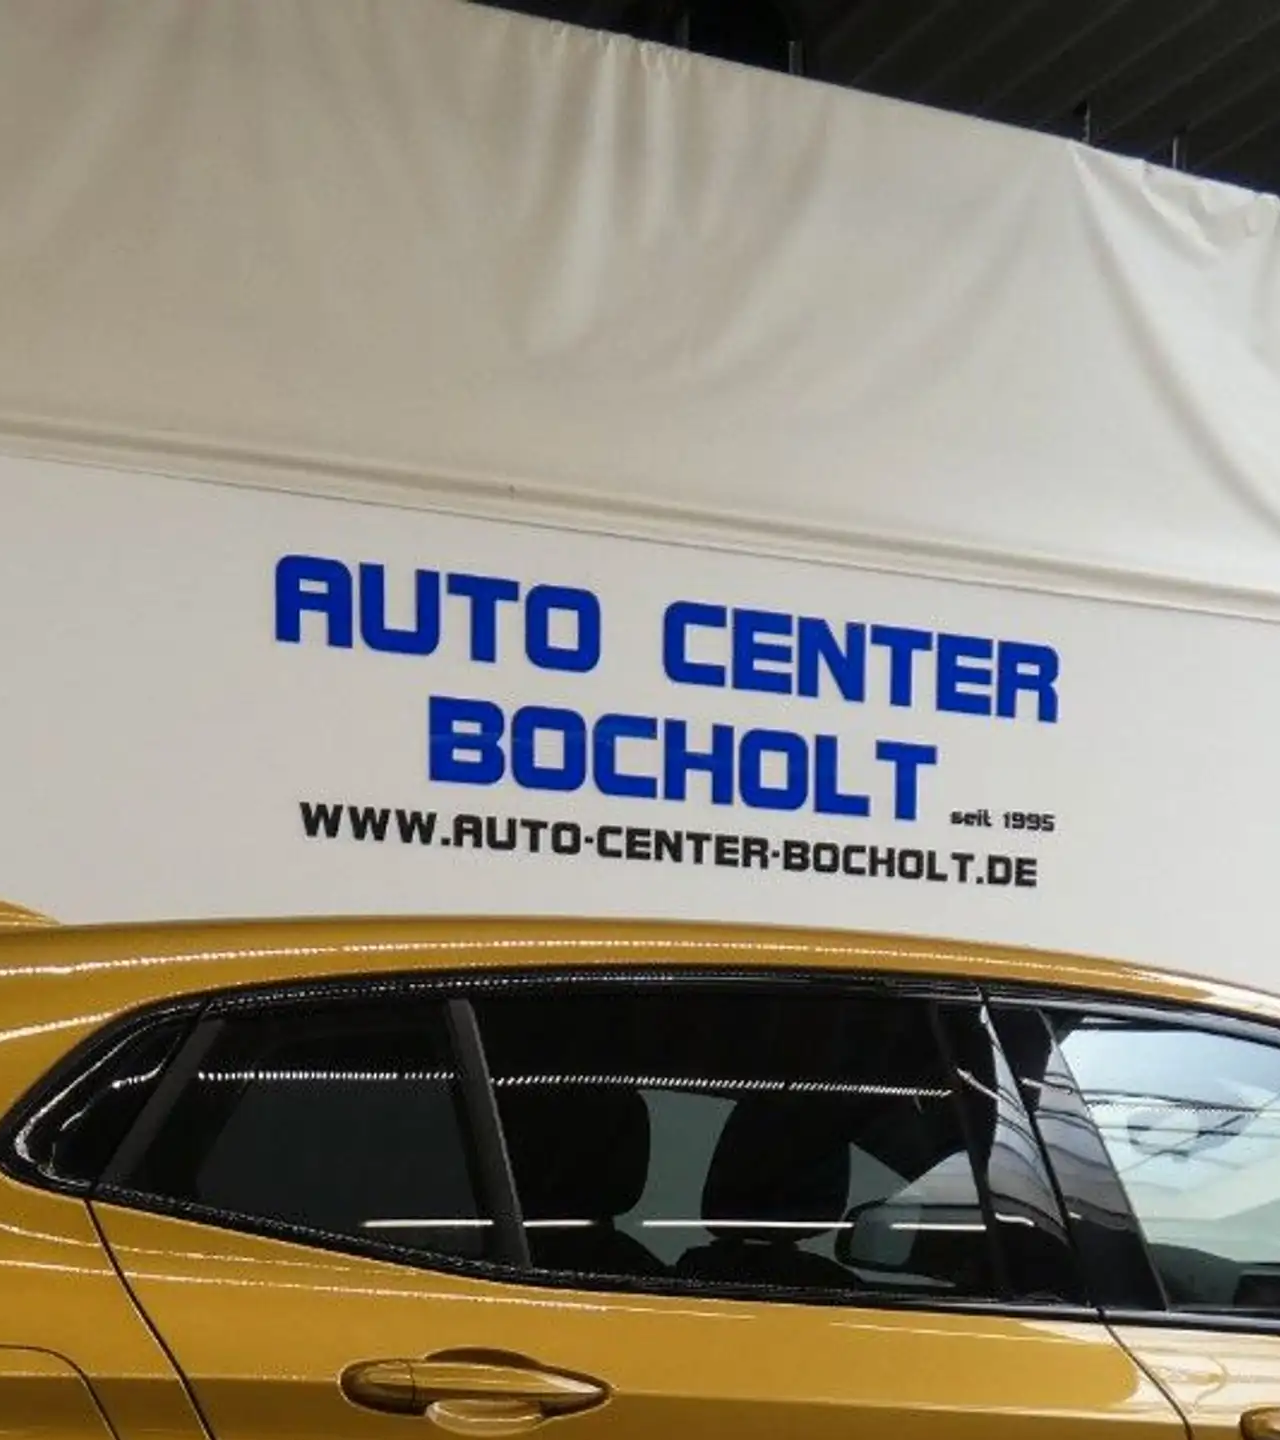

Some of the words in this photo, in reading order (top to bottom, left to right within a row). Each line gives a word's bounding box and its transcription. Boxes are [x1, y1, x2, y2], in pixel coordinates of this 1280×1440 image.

[275, 555, 601, 674] AUTO
[663, 602, 1061, 726] CENTER
[428, 696, 938, 823] BOCHOLT
[299, 801, 1038, 888] WWW.AUTO-CENTER-BOCHOLT.DE
[949, 809, 992, 828] seit
[1003, 811, 1056, 832] 1995
